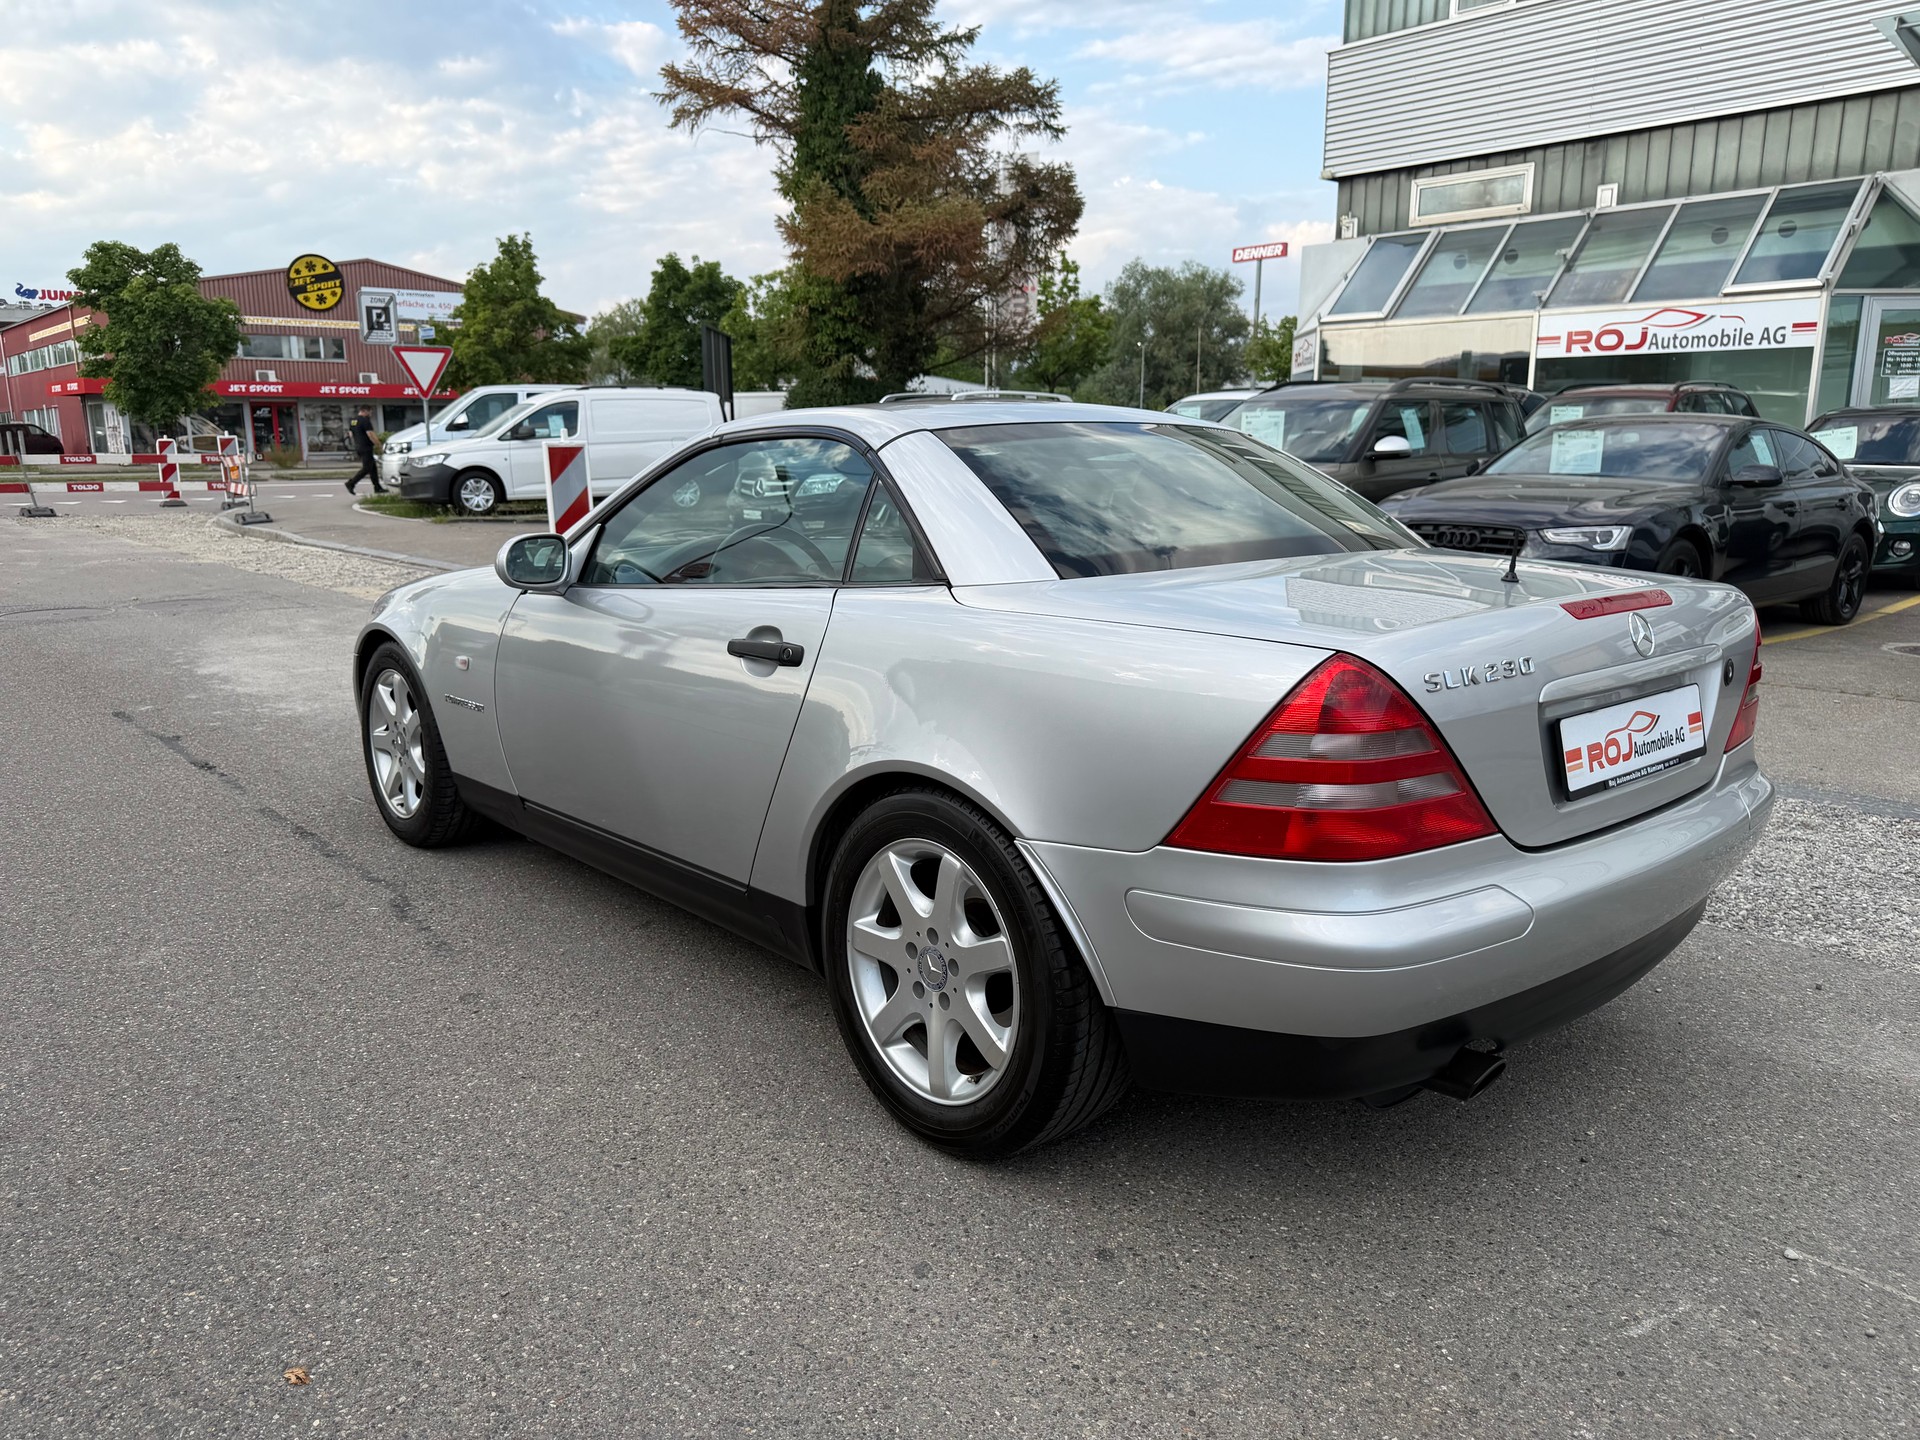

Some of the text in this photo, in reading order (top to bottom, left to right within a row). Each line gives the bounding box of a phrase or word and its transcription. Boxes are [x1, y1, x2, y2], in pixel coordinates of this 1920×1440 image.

[1234, 244, 1283, 261] DENNER
[306, 279, 342, 292] SPORT
[1566, 326, 1787, 353] ROJ Automobile AG
[228, 384, 284, 393] JET SPORT
[319, 386, 371, 394] JET SPORT
[1423, 656, 1536, 693] SLK 230
[1587, 726, 1686, 773] ROJ Automobile AG
